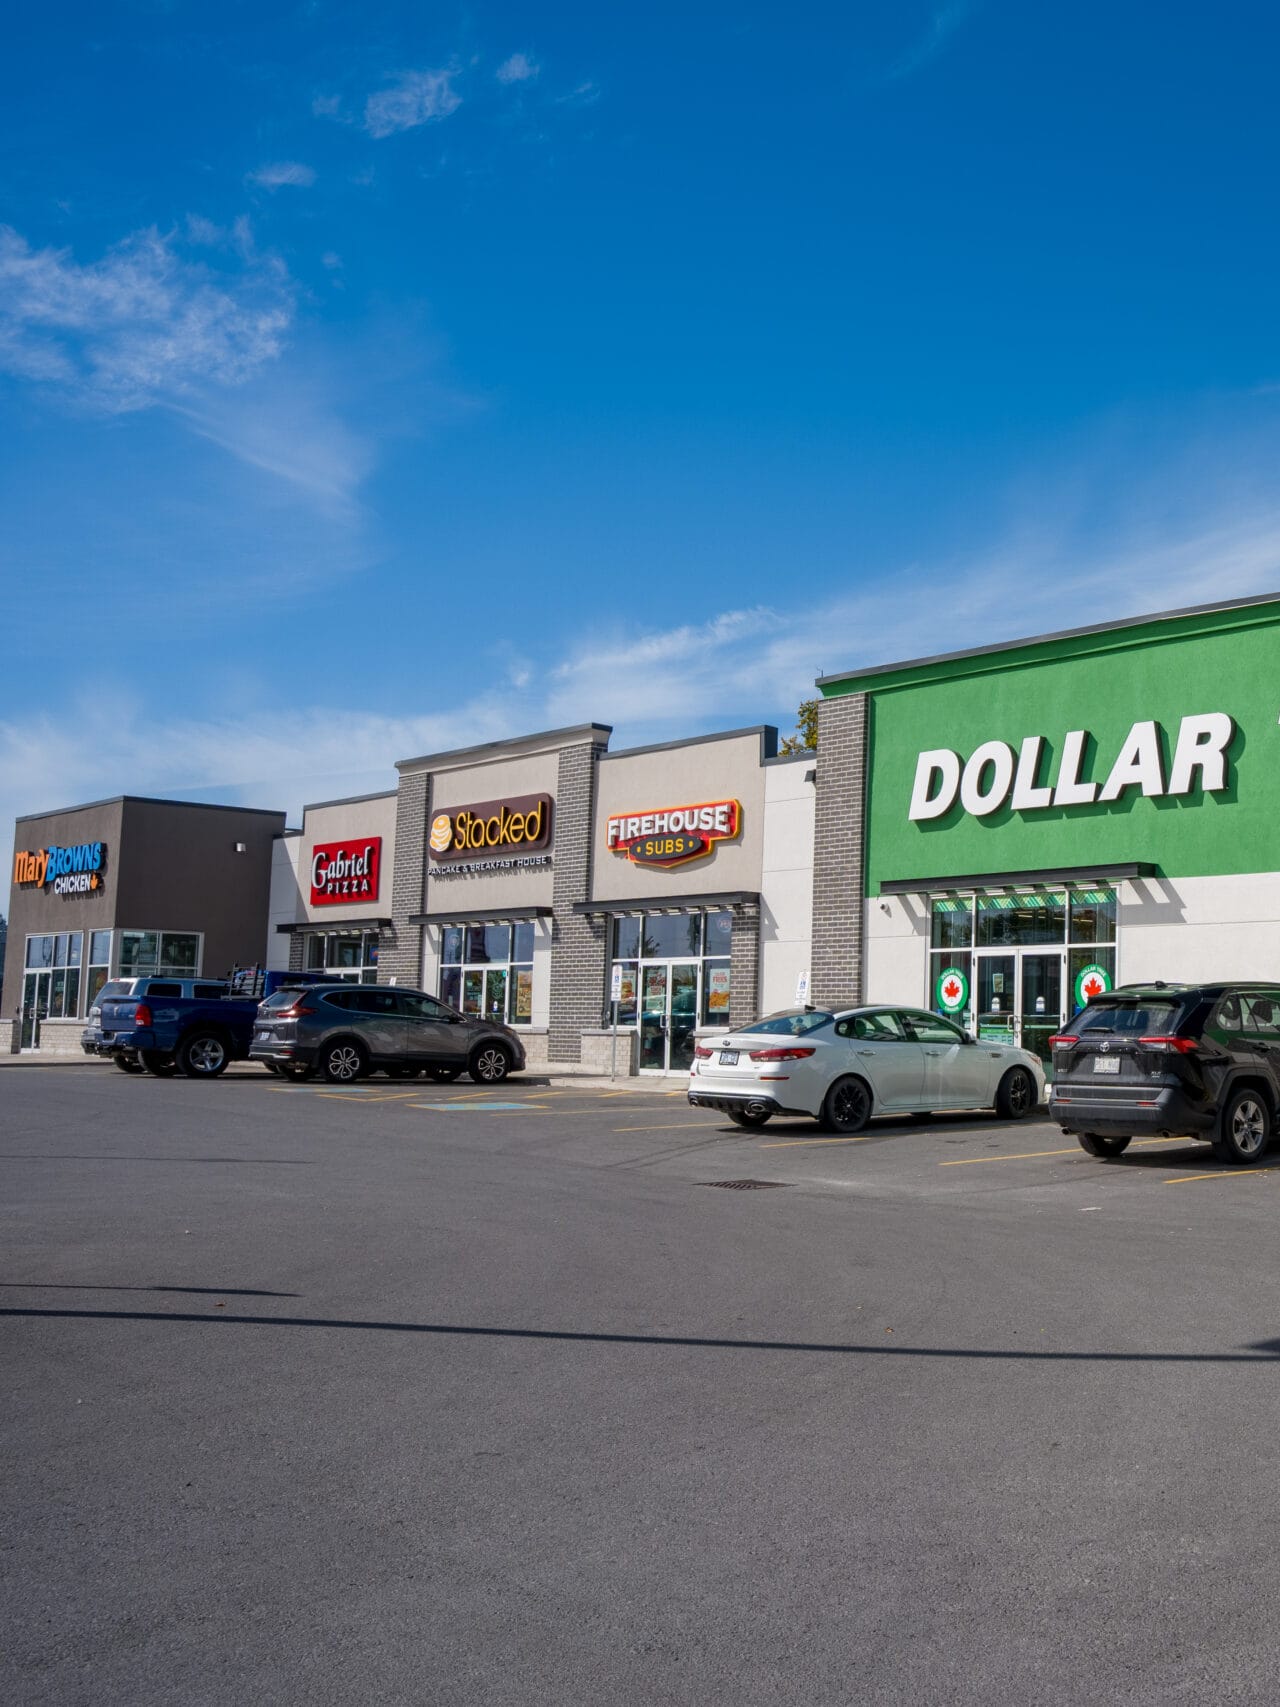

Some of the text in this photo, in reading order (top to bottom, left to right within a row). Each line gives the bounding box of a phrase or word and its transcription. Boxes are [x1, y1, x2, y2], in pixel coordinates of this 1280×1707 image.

[908, 711, 1235, 821] DOLLAR
[454, 801, 542, 850] Stacked
[607, 804, 730, 846] FIREHOUSE
[645, 838, 684, 855] SUBS
[311, 846, 372, 889] Gabriel
[427, 865, 460, 875] PANCAKE
[470, 860, 514, 872] BREAKFAST
[518, 855, 547, 867] HOUSE
[54, 873, 91, 894] CHICKEN
[327, 879, 369, 894] PIZZA
